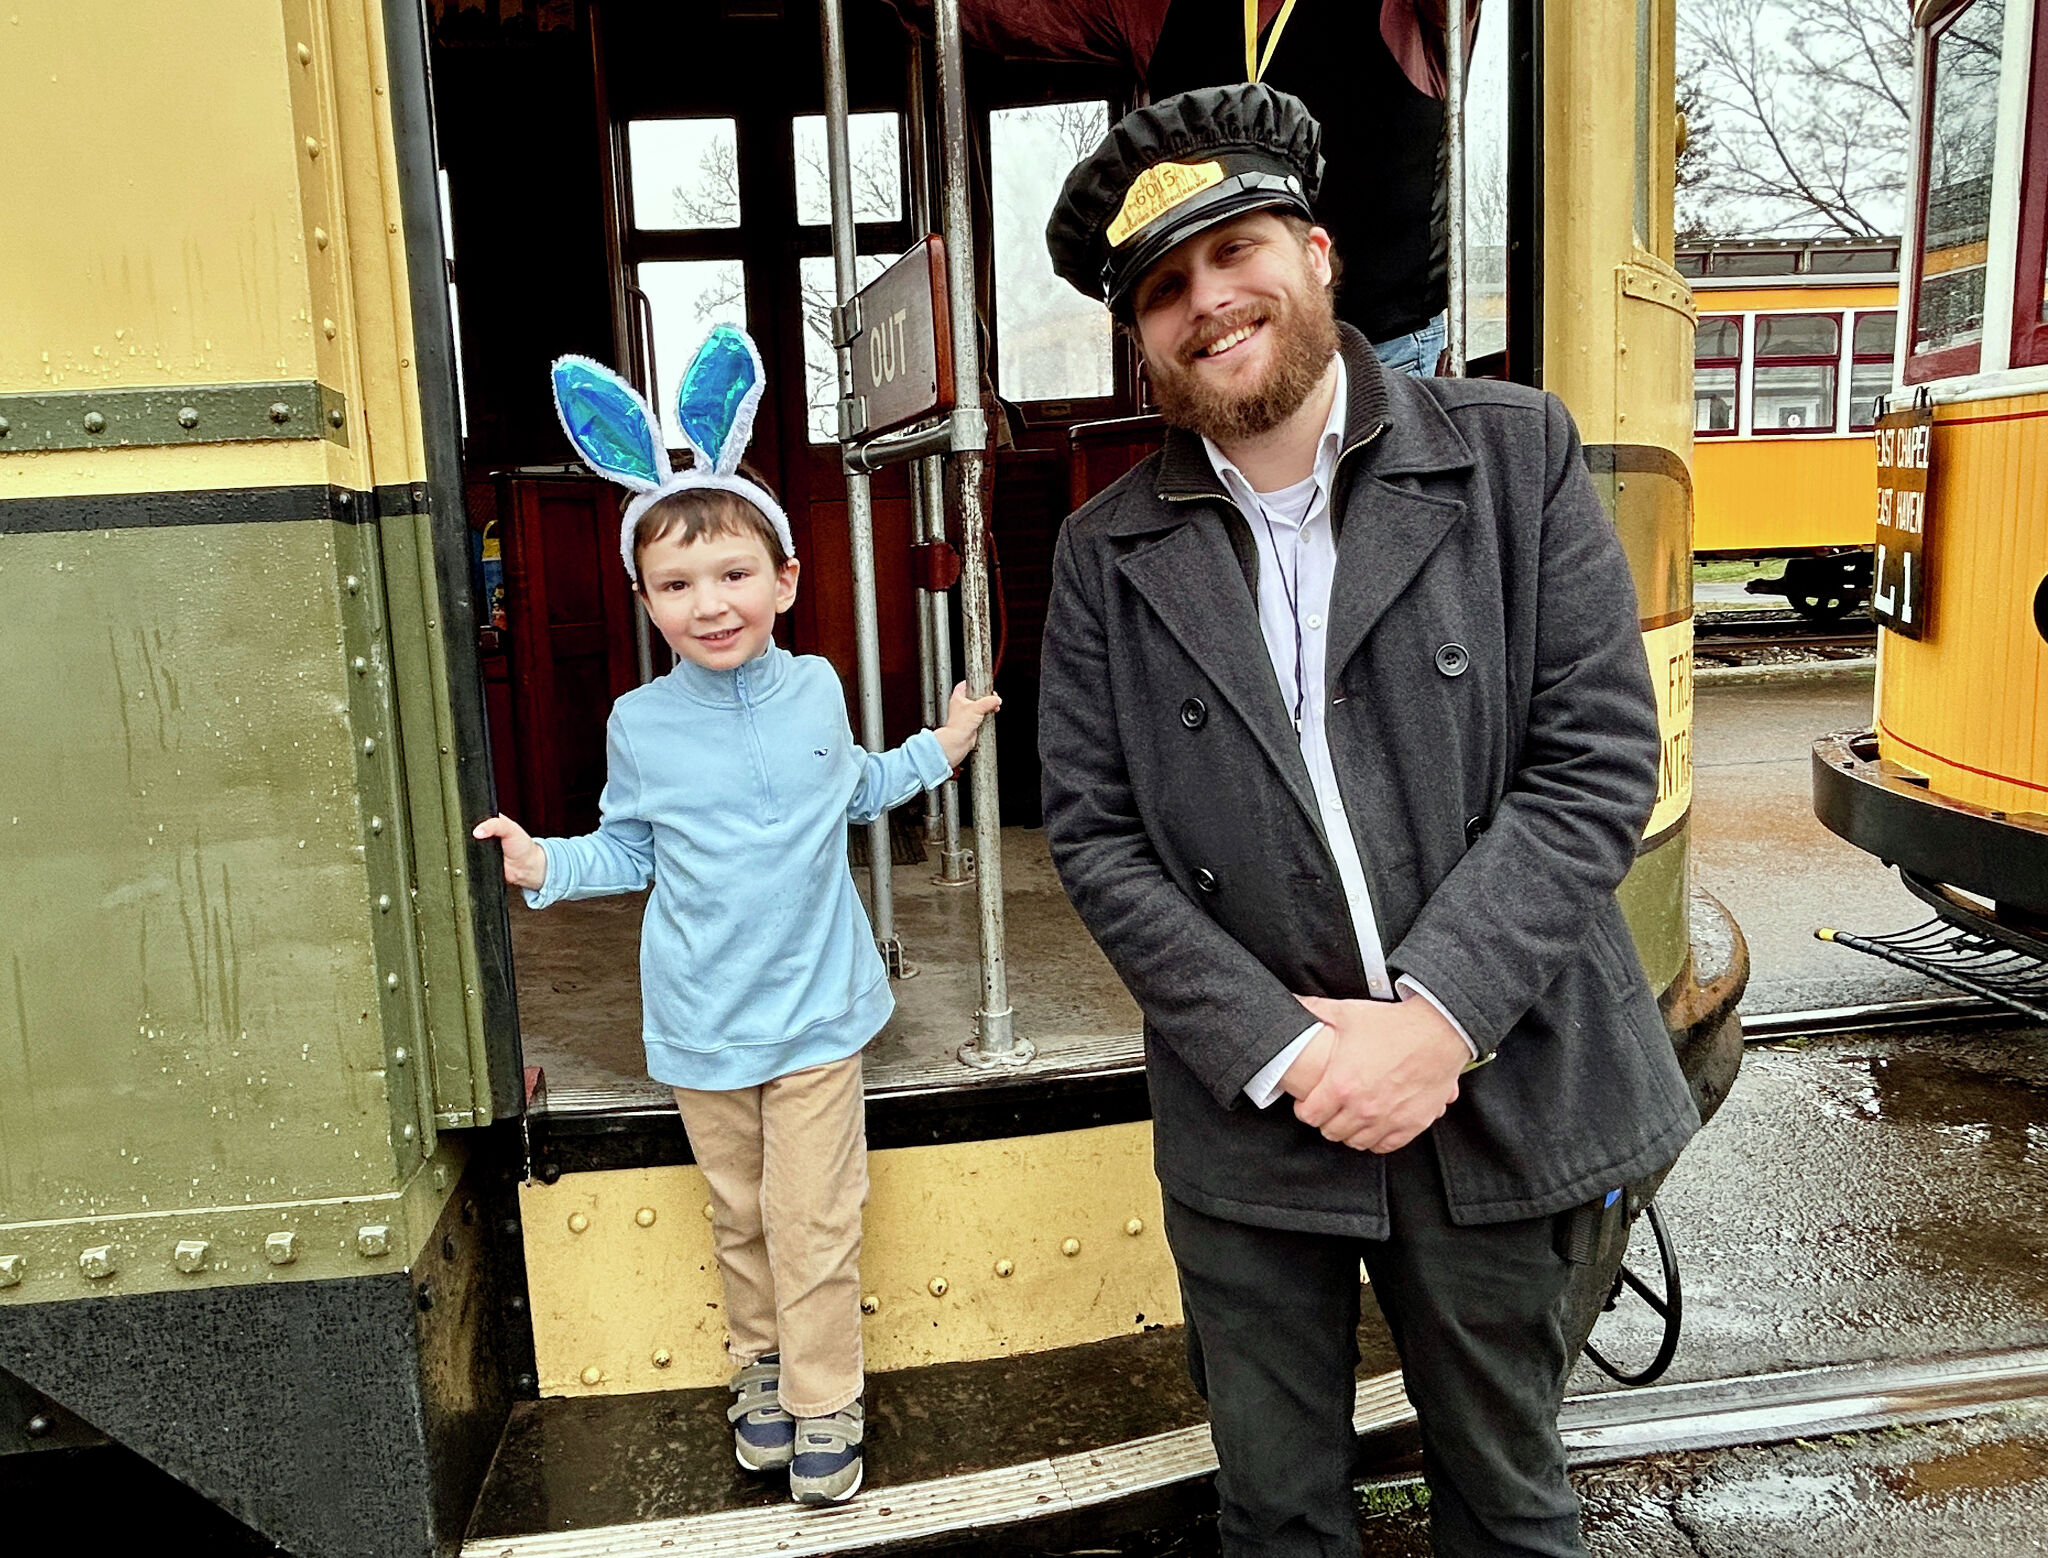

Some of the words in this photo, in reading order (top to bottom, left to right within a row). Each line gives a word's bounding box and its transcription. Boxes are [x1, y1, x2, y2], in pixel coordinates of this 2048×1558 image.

[1135, 170, 1175, 205] 6015
[1151, 192, 1183, 215] ELECTRIC
[869, 308, 907, 388] OUT
[1875, 428, 1895, 467] EAST
[1896, 425, 1930, 469] CHAPEL
[1876, 488, 1893, 527] EAST
[1895, 491, 1924, 534] HAVEN
